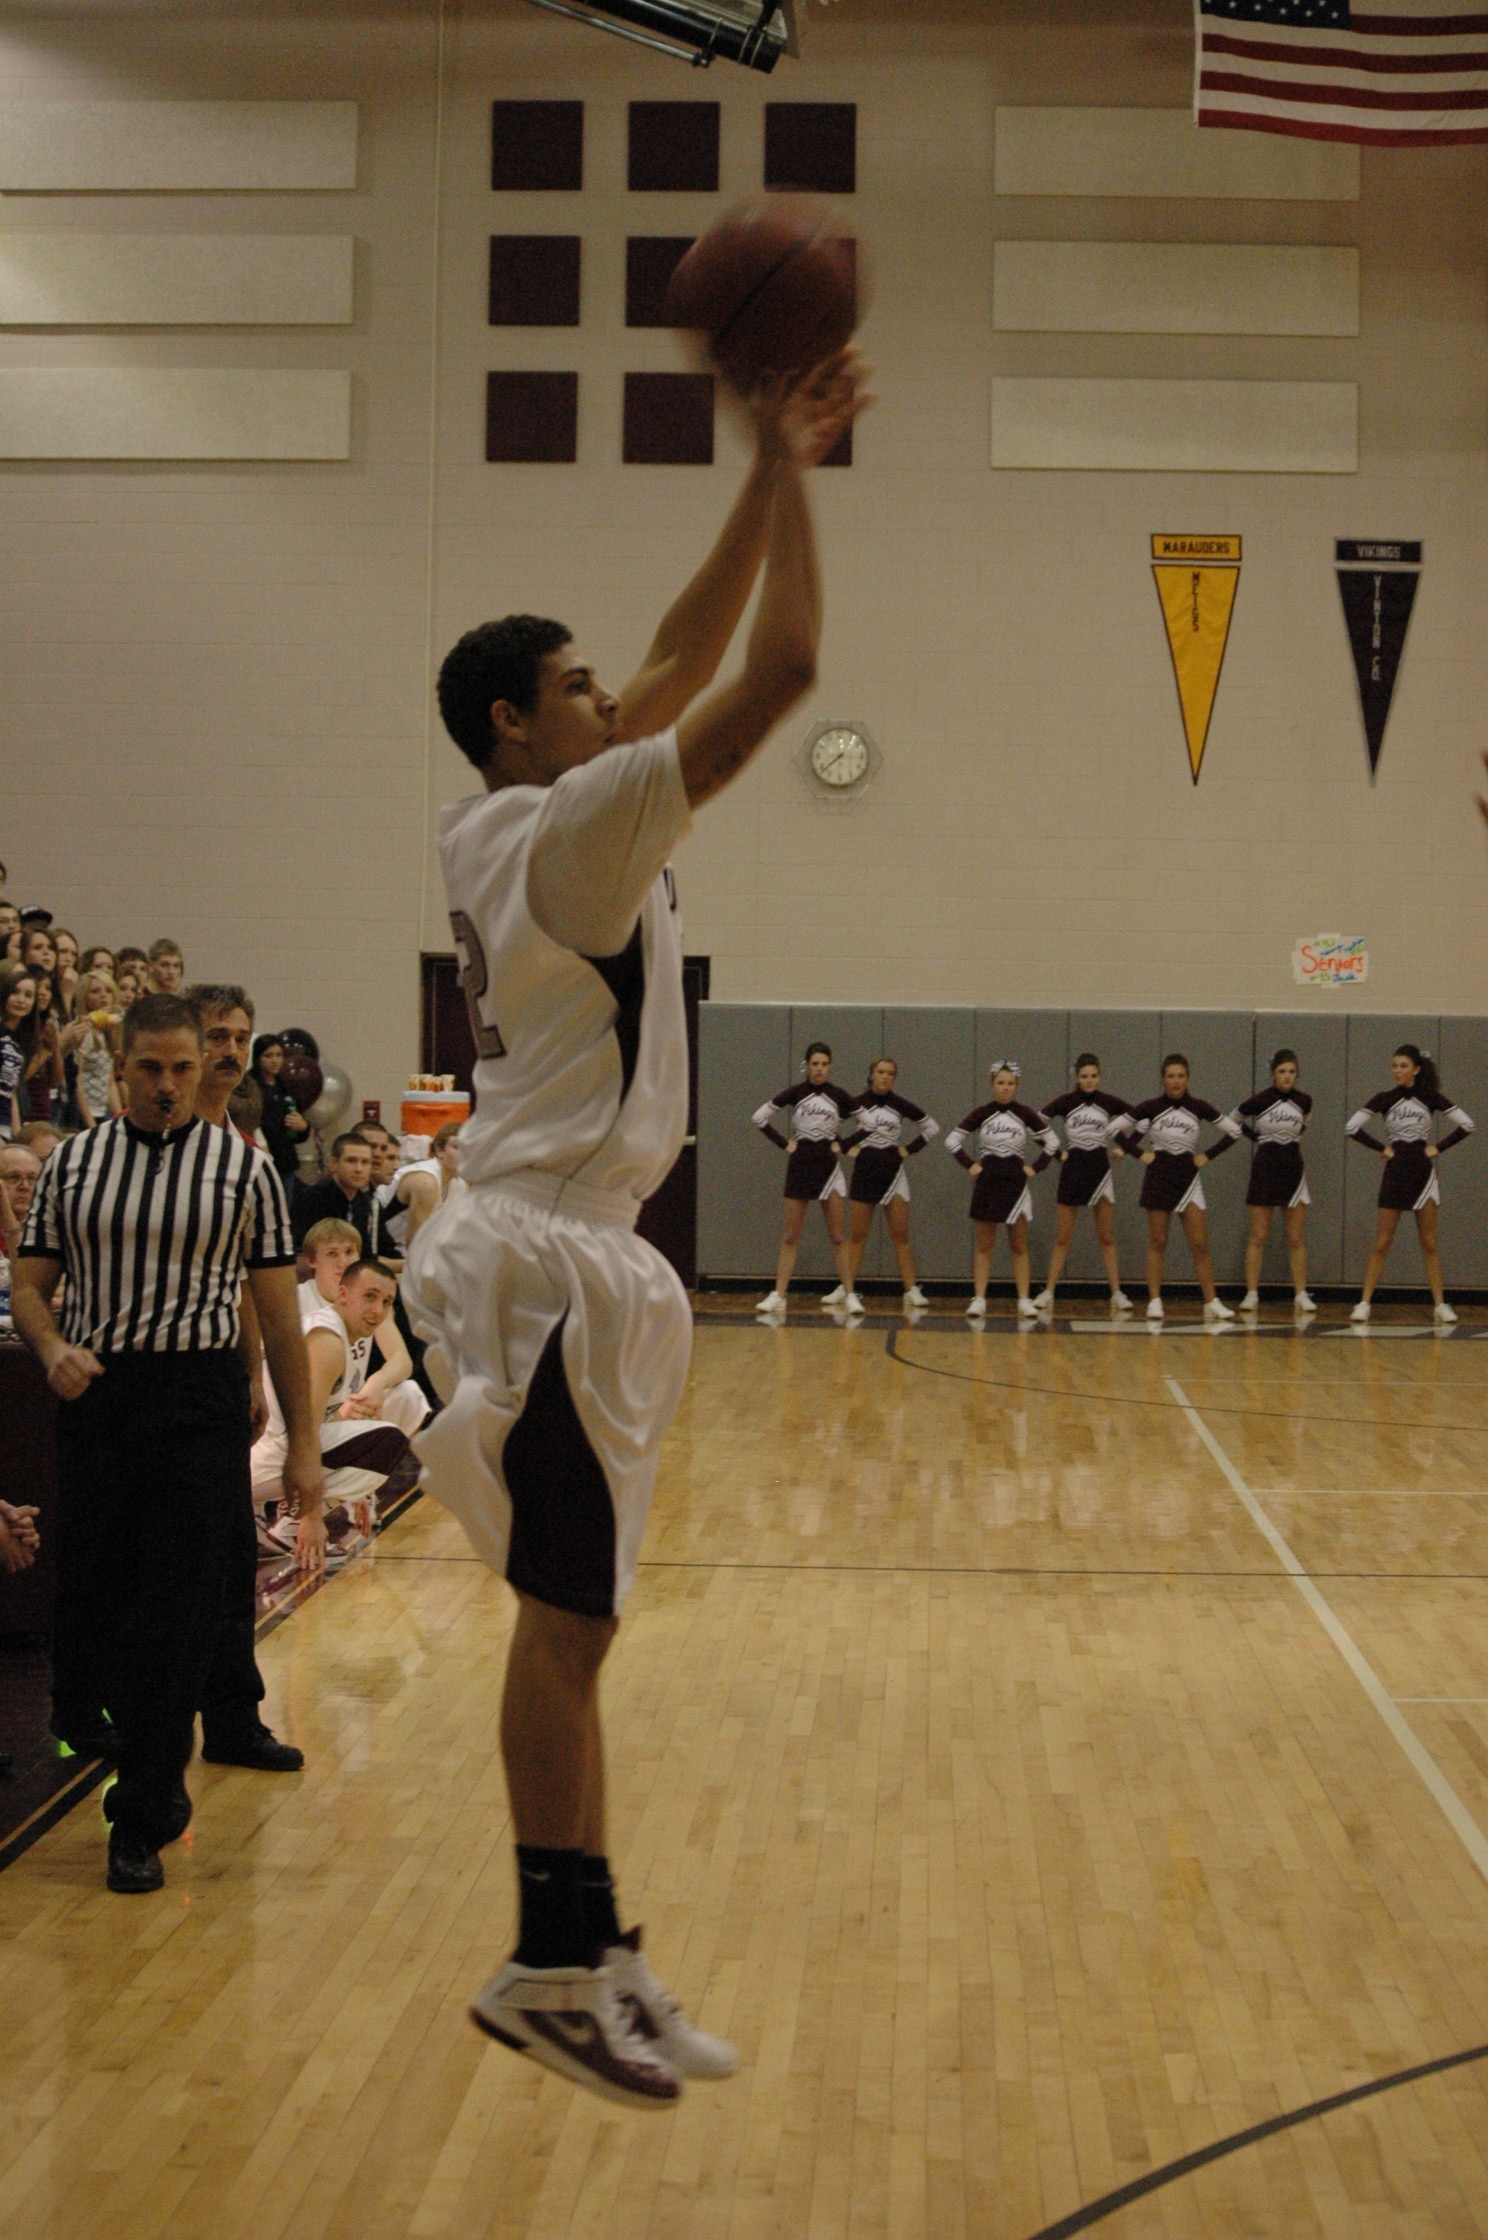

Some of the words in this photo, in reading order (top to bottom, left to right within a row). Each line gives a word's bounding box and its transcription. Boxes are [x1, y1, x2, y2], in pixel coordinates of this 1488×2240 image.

[1162, 541, 1230, 554] MARAUDERS
[1356, 544, 1401, 559] VIKINGS
[1301, 944, 1364, 974] Seniors
